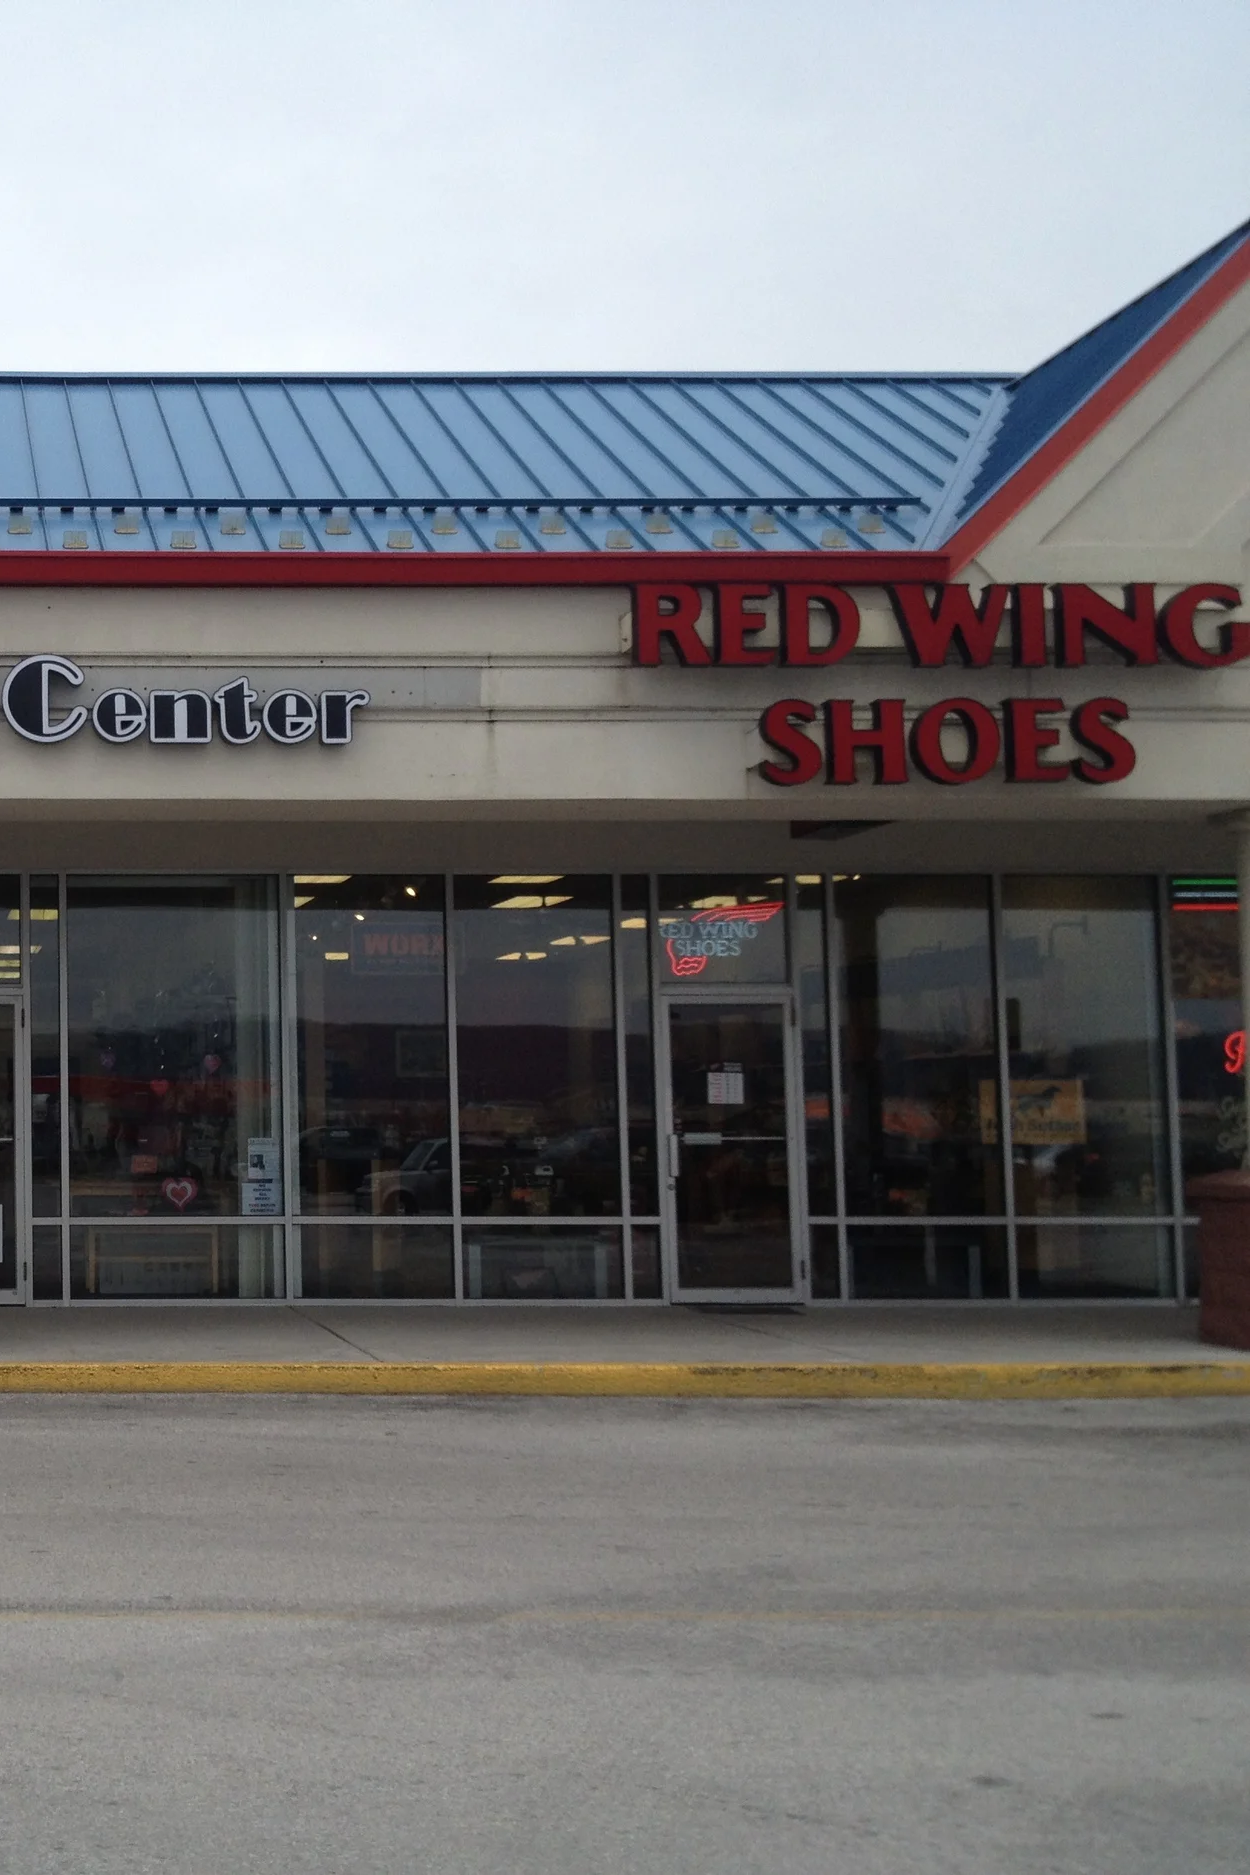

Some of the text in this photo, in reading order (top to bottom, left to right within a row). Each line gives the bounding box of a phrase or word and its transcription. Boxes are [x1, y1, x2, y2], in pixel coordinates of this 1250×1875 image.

[632, 583, 1250, 668] RED WING
[2, 654, 371, 744] Center
[758, 697, 1136, 786] SHOES
[676, 940, 742, 957] SHOES
[698, 921, 758, 939] WING
